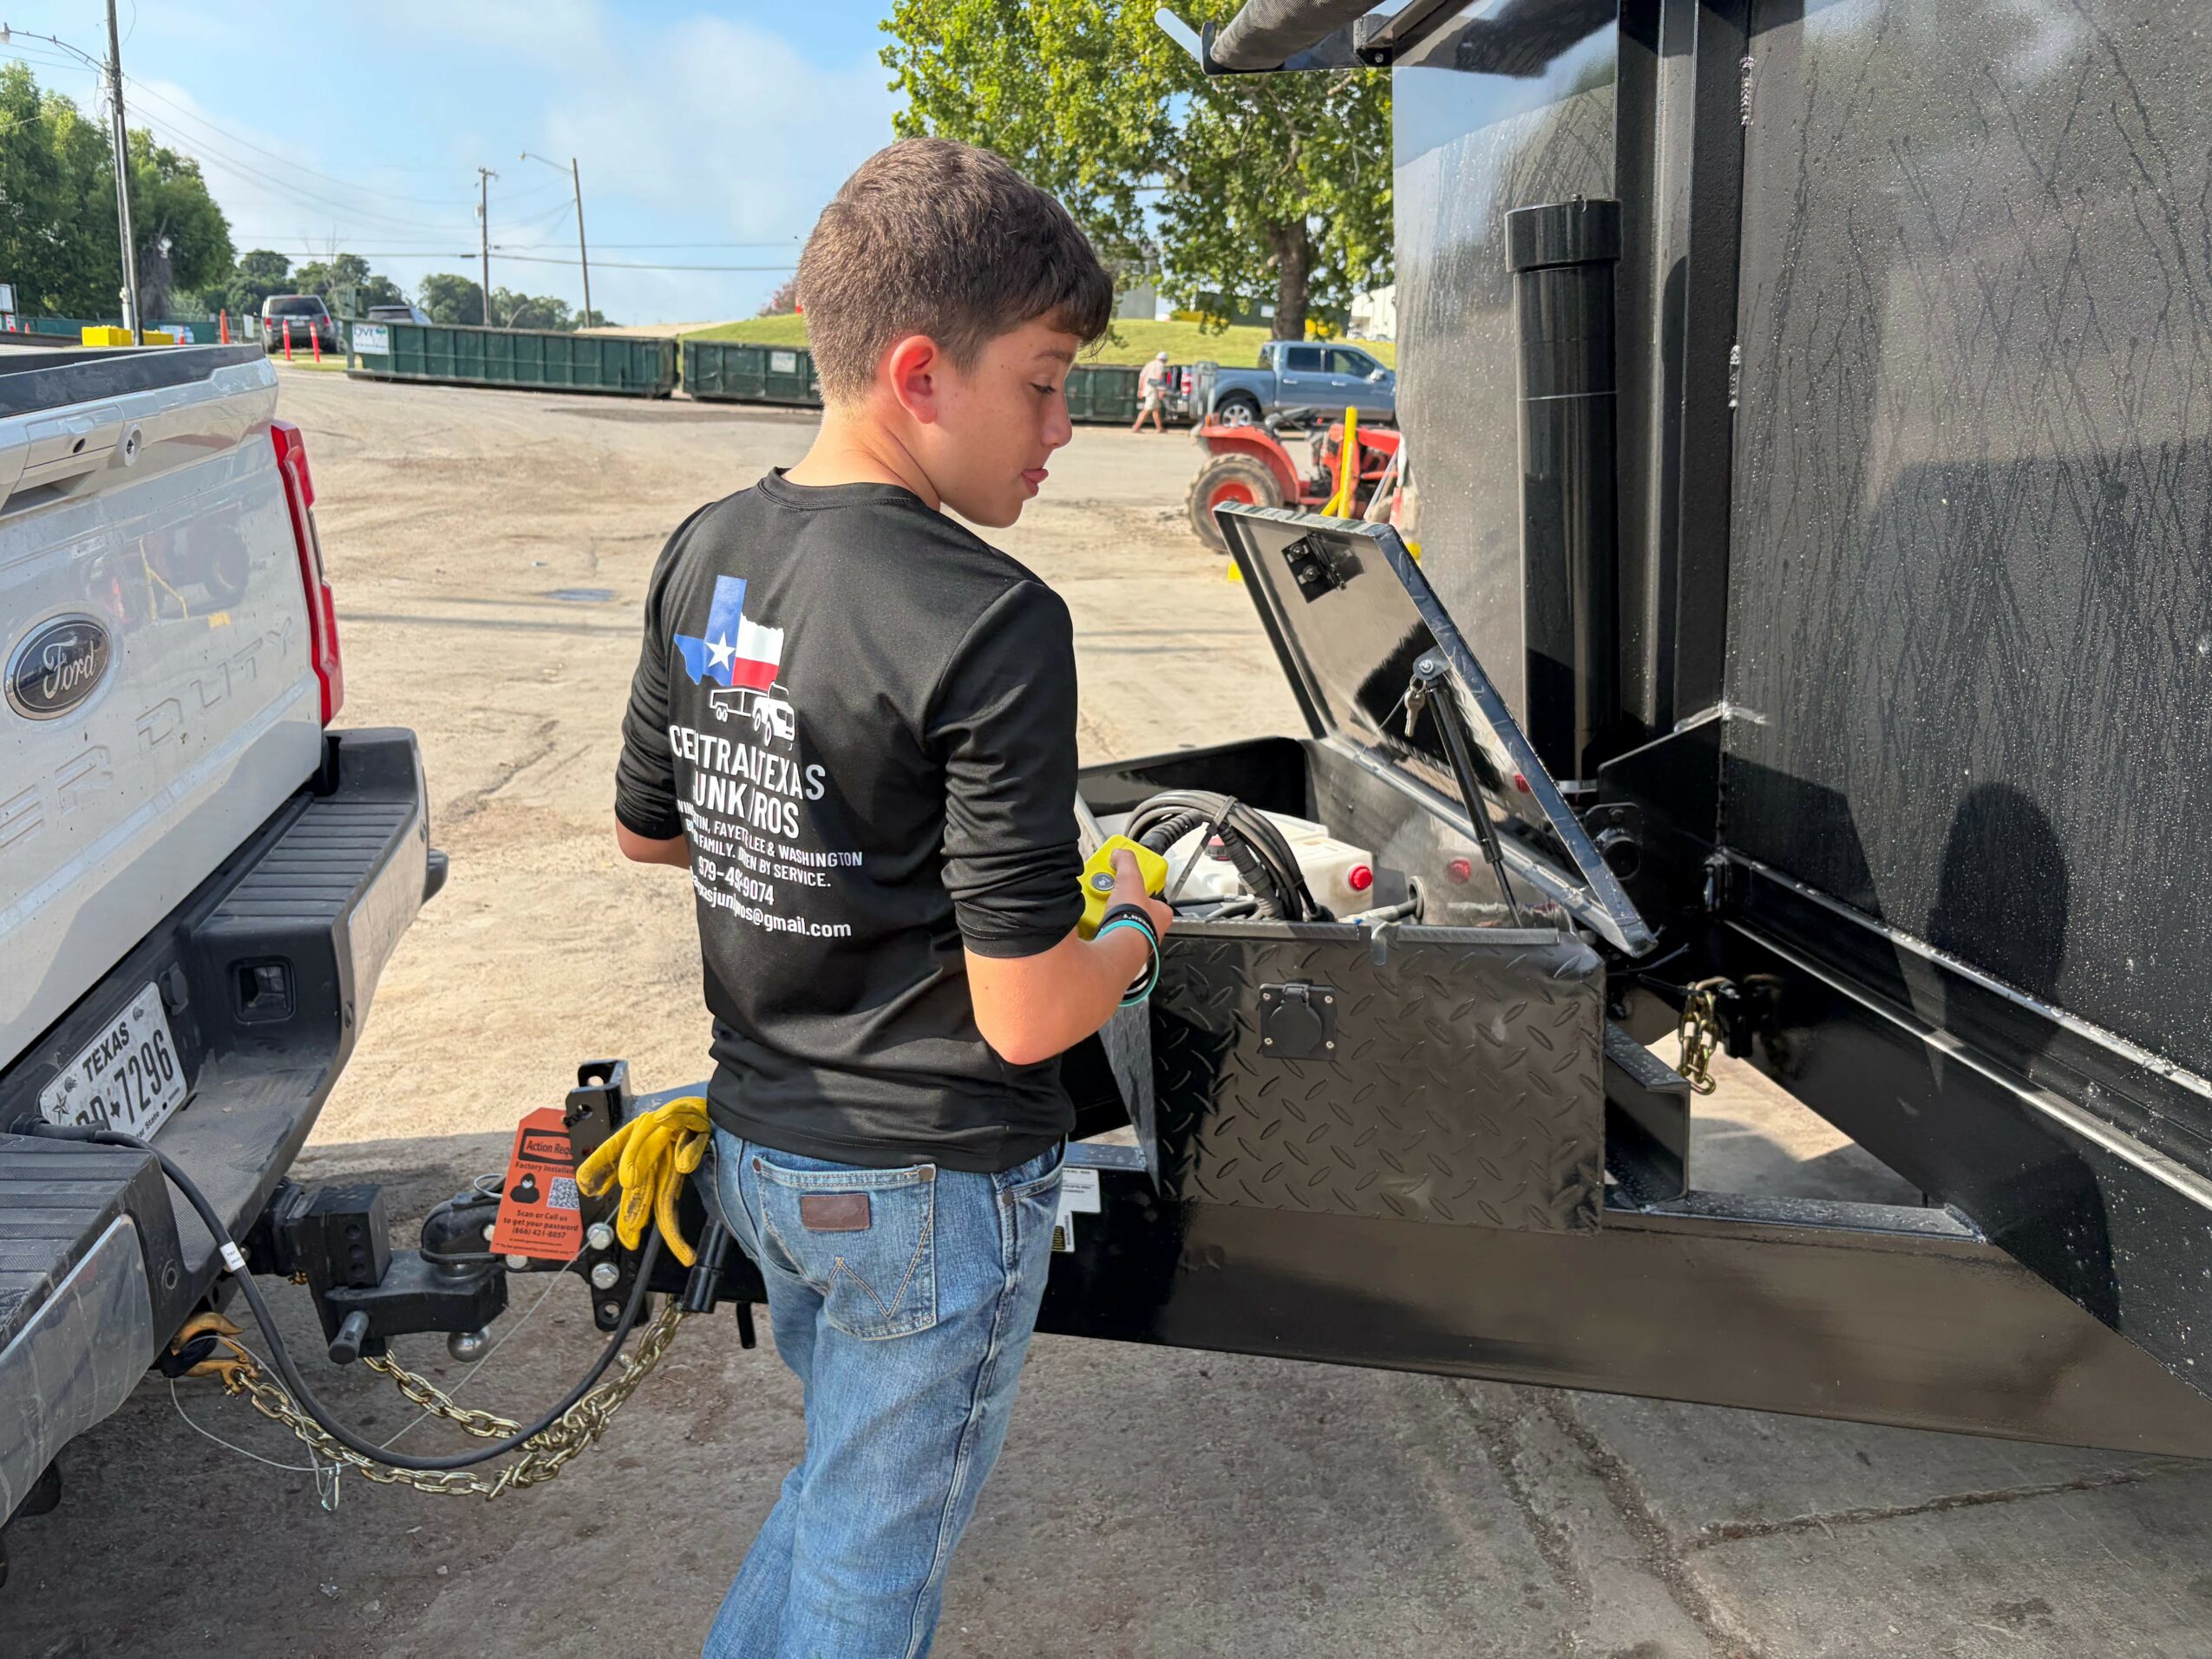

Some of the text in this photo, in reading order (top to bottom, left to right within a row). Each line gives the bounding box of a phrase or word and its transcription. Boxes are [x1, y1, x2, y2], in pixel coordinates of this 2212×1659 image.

[43, 633, 96, 700] Ford
[135, 615, 293, 761] DUTY
[748, 787, 799, 839] ROS
[699, 834, 736, 858] FAMILY.
[759, 858, 771, 875] BY
[773, 864, 831, 887] SERVICE.
[767, 841, 776, 857] &
[778, 844, 862, 867] WASHINGTON
[82, 1022, 129, 1083] TEXAS
[527, 1140, 553, 1153] Action
[515, 1161, 542, 1172] Factory
[517, 1209, 535, 1218] Scan
[545, 1212, 559, 1221] Call
[544, 1223, 579, 1231] password
